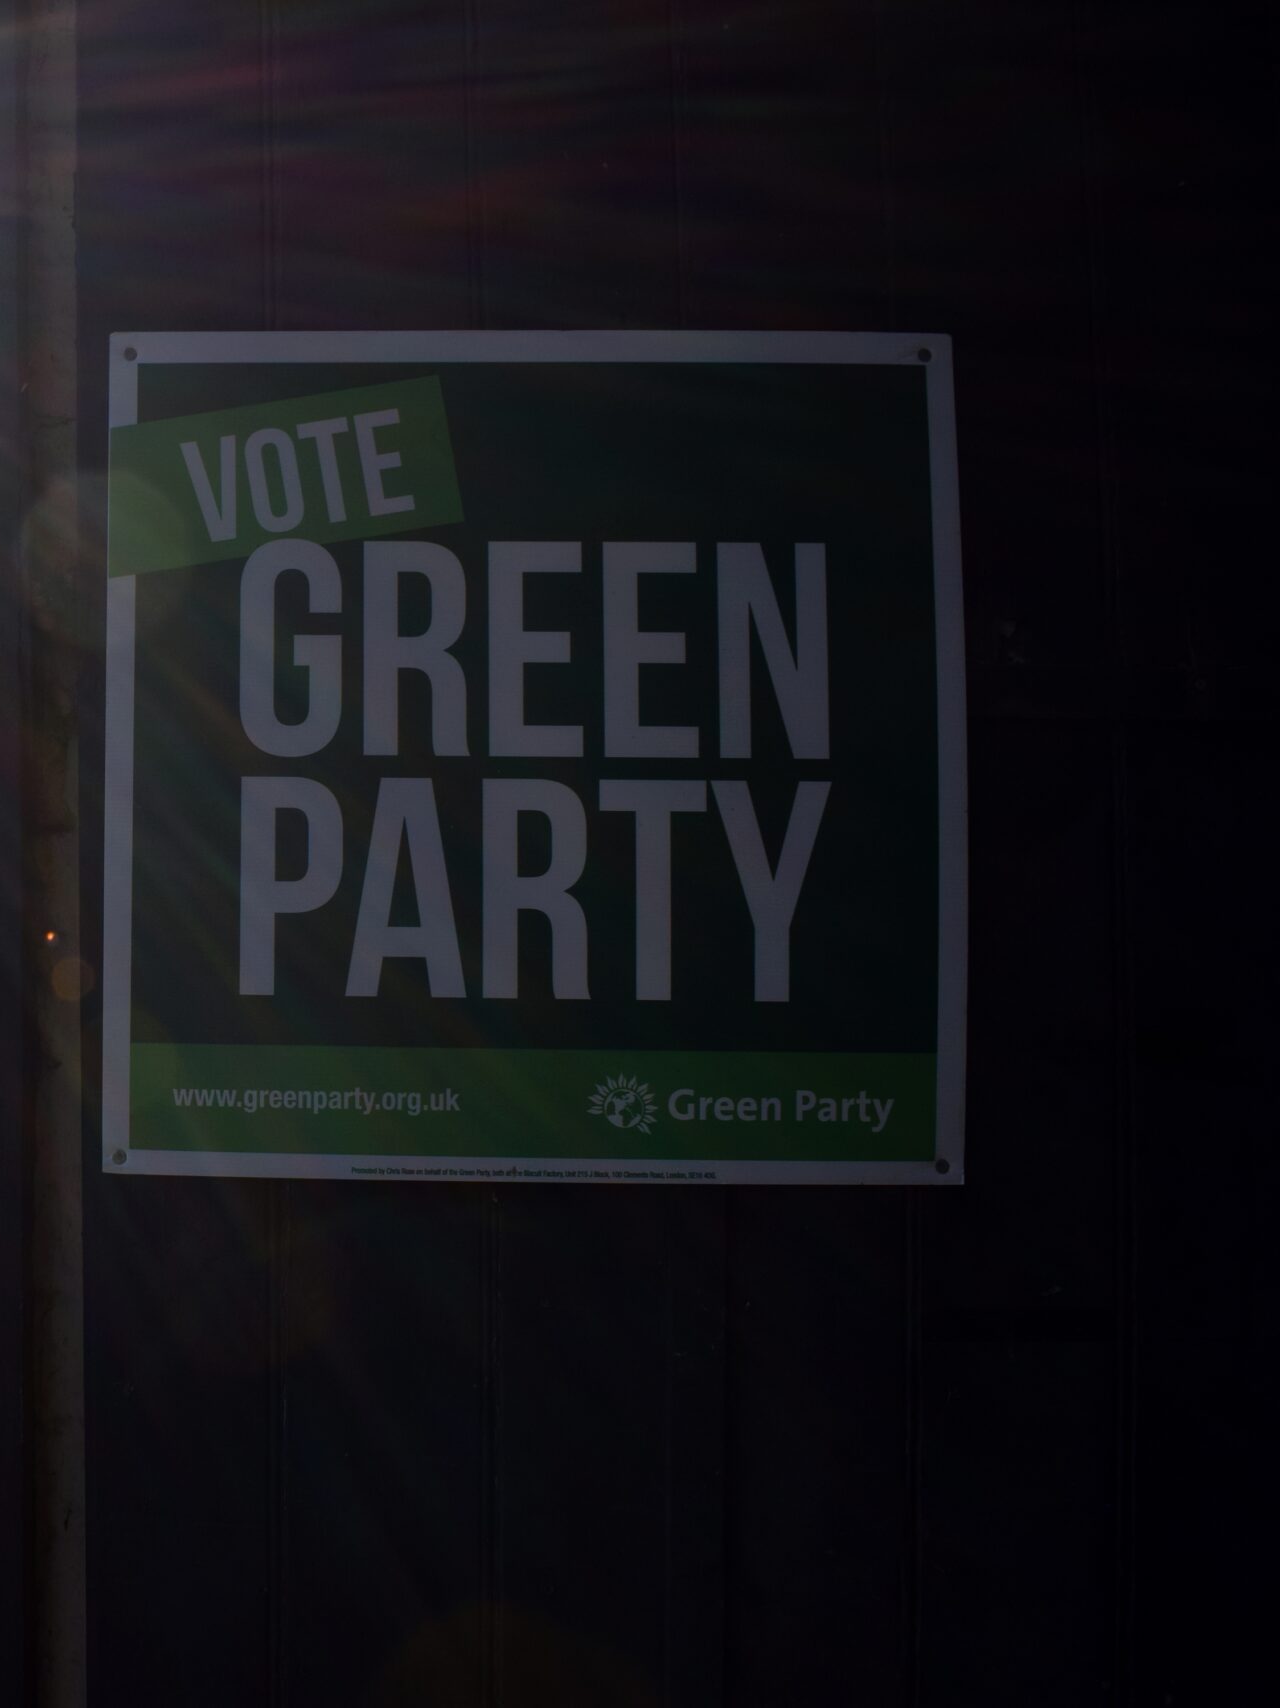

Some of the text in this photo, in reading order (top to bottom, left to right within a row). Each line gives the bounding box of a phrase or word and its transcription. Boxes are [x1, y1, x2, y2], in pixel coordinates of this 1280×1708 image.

[181, 408, 415, 542] VOTE
[238, 540, 831, 761] GREEN
[238, 777, 833, 1003] PARTY
[173, 1086, 460, 1117] www.greenparty.org.uk
[668, 1088, 894, 1132] Green Party
